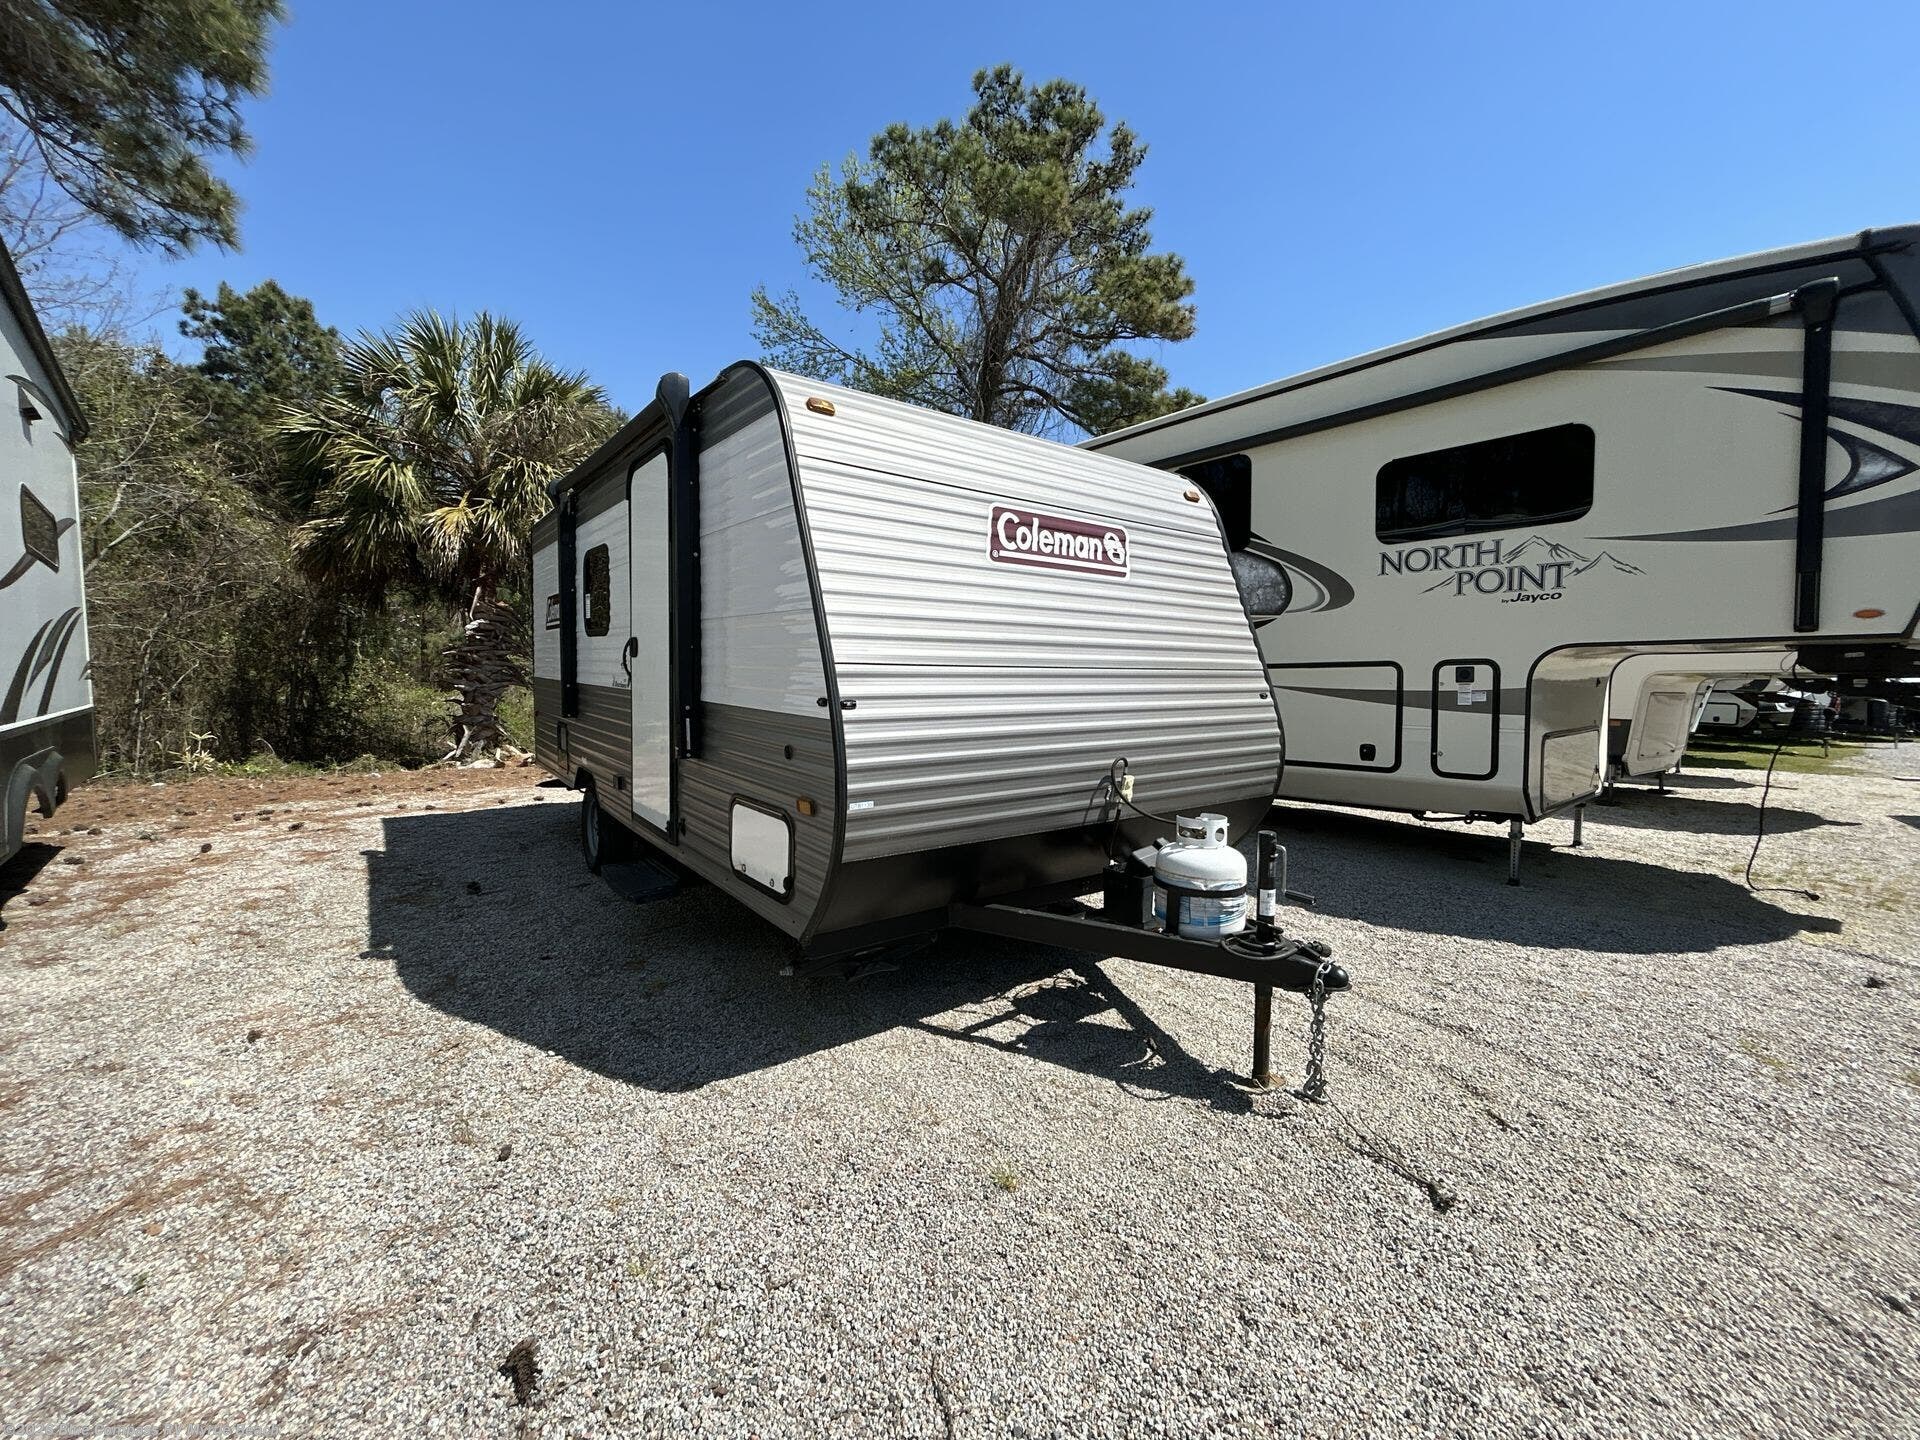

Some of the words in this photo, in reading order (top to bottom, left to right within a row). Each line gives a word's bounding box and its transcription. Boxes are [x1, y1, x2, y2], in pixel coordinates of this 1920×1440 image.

[997, 511, 1103, 561] Coleman
[1378, 538, 1504, 577] NORTH
[1453, 560, 1574, 597] POINT
[1510, 592, 1562, 604] Jayco
